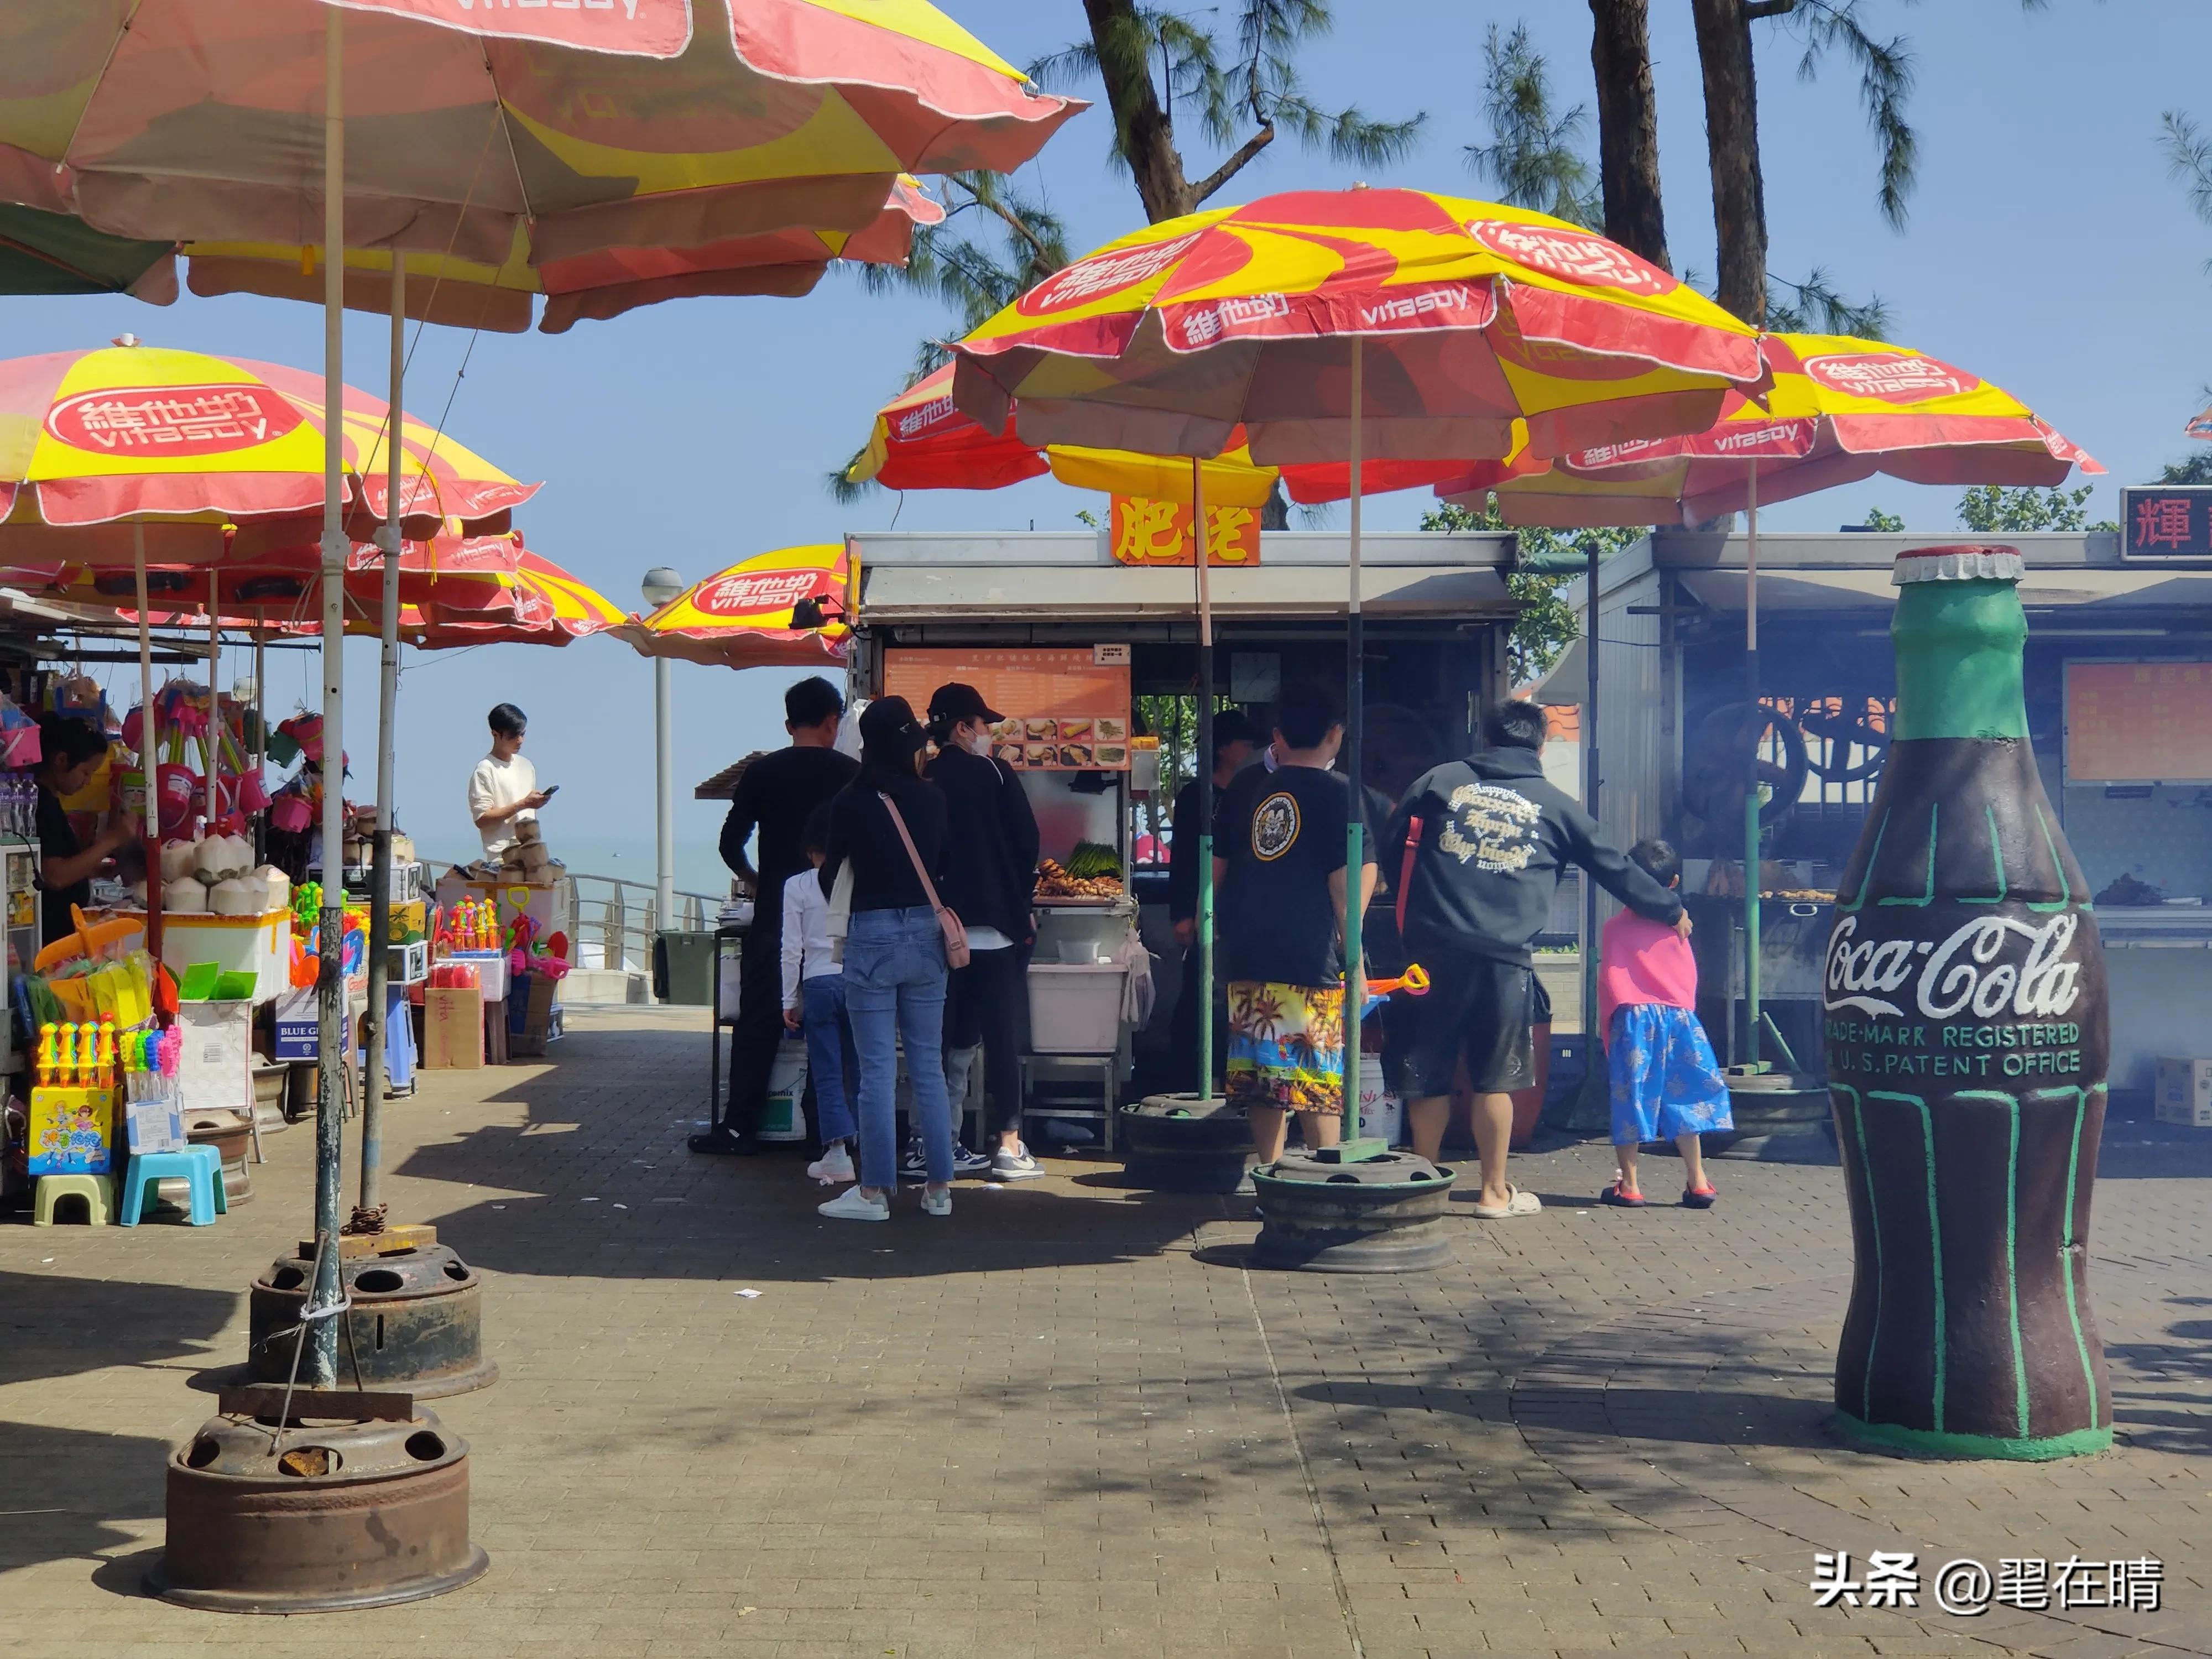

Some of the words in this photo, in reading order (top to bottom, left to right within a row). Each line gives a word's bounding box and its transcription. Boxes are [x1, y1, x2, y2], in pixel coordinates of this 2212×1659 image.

[1053, 231, 1204, 290] 維他奶
[1183, 292, 1289, 346] 維他奶
[1361, 286, 1468, 325] vitasoy
[1841, 377, 1960, 394] vitasoy
[77, 391, 263, 430] 維他奶
[90, 418, 267, 448] vitasoy
[1714, 423, 1798, 451] vitasoy
[1116, 496, 1254, 561] 肥佬
[2135, 498, 2212, 549] 輝
[711, 590, 809, 610] vitasoy
[716, 572, 818, 598] 維他奶
[1824, 913, 2079, 1020] Coca-Cola
[281, 1027, 306, 1036] BLUE
[1943, 1021, 2079, 1048] REGISTERED
[2002, 1049, 2080, 1076] OFFICE
